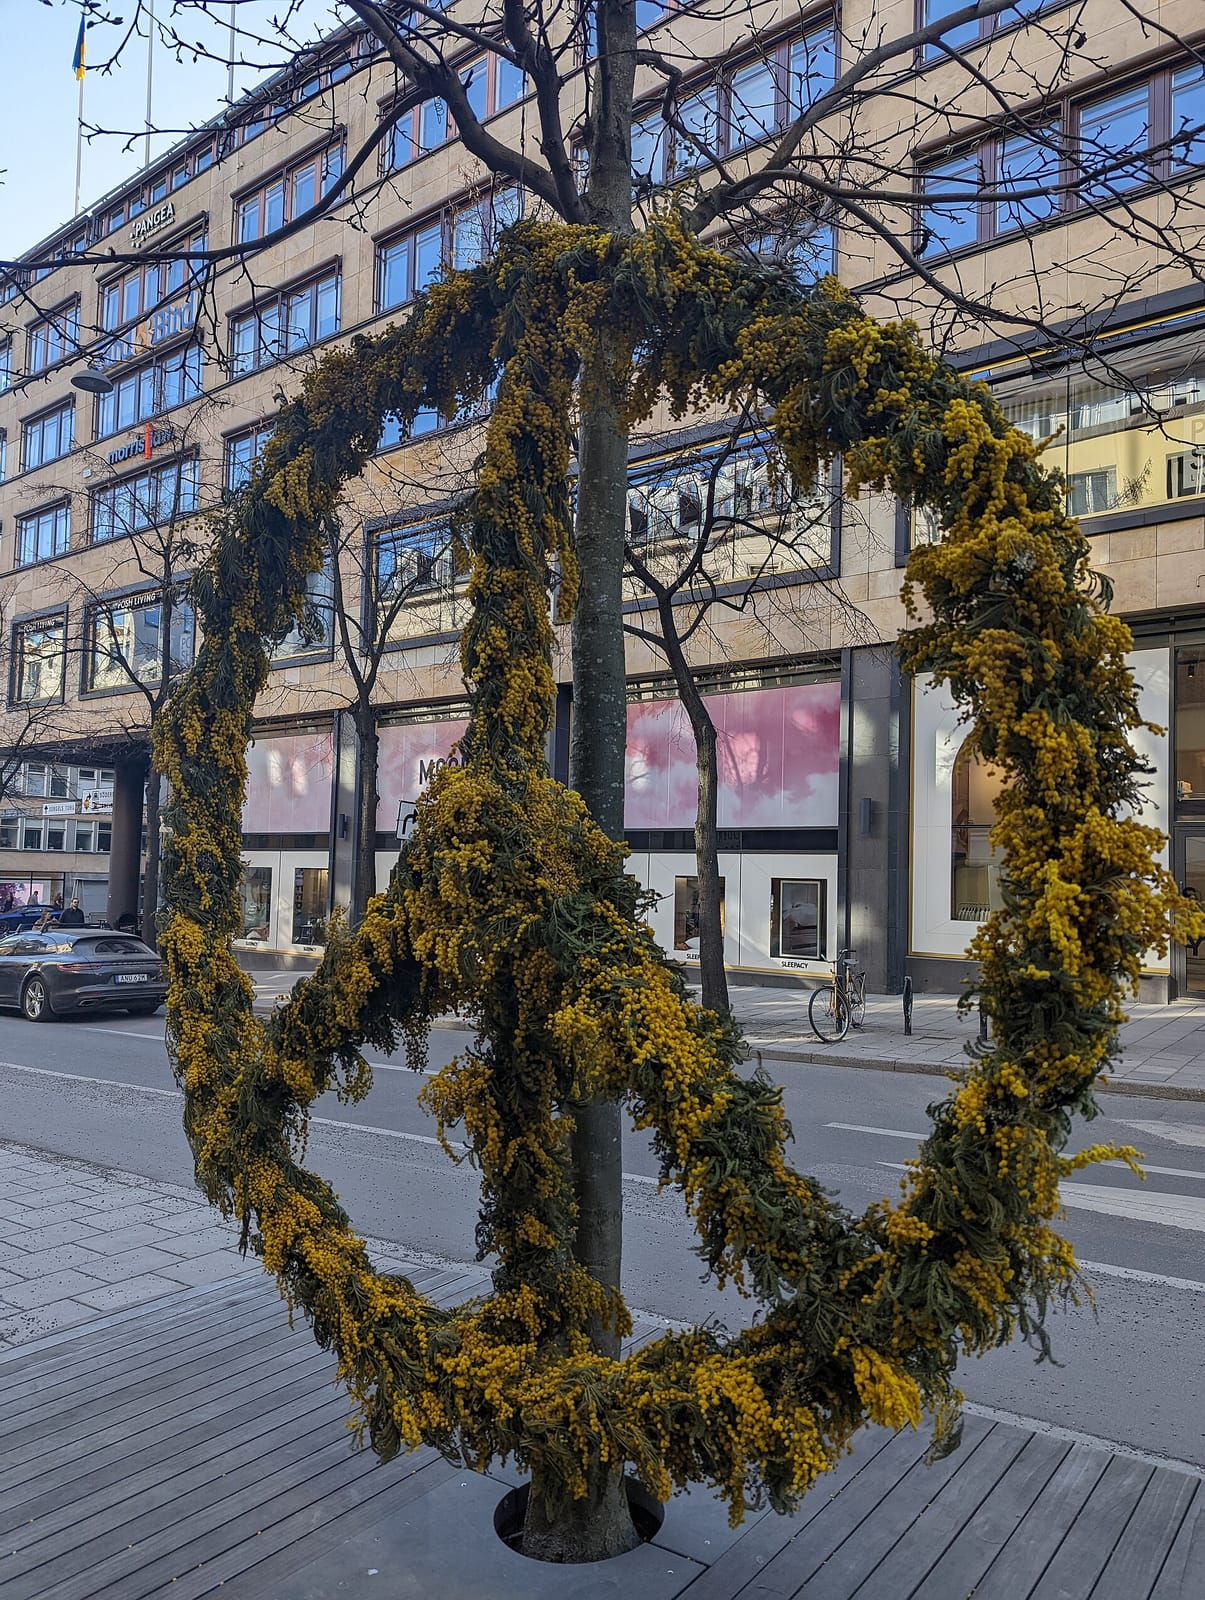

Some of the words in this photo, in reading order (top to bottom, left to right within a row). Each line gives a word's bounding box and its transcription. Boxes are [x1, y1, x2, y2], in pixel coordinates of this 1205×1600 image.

[135, 202, 174, 238] PANGEA
[107, 434, 145, 465] morris
[134, 592, 156, 605] LIVING
[781, 960, 809, 969] SLEEPACY
